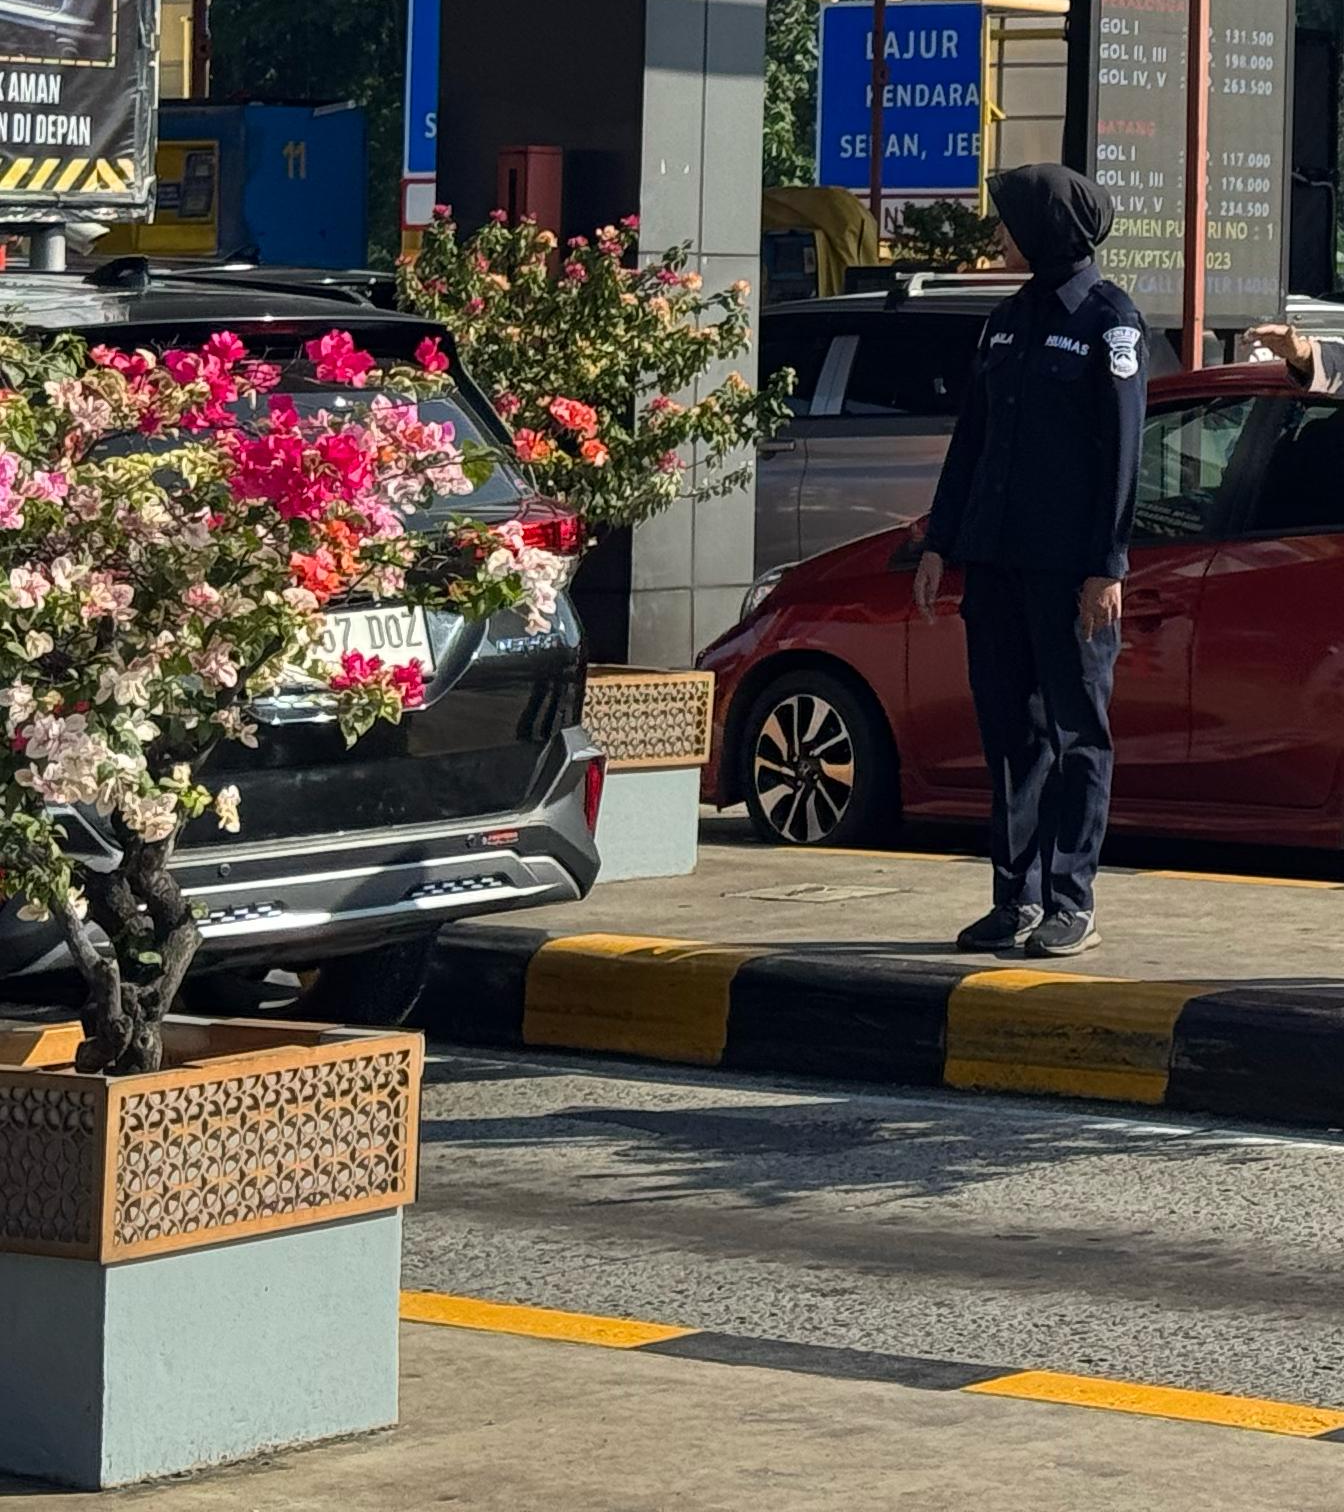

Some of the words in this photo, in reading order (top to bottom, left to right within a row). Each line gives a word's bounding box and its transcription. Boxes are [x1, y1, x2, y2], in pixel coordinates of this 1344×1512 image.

[1100, 18, 1129, 35] GOL
[1099, 43, 1129, 60] GOL
[1098, 69, 1128, 85] GOL
[8, 72, 61, 105] AMAN
[12, 113, 32, 143] DI
[35, 114, 91, 147] DEPAN
[840, 133, 927, 161] SEAN,
[1097, 144, 1126, 161] GOL
[282, 140, 306, 179] 11
[1096, 170, 1125, 186] GOL
[1109, 218, 1161, 238] EPMEN
[1225, 222, 1248, 239] NO
